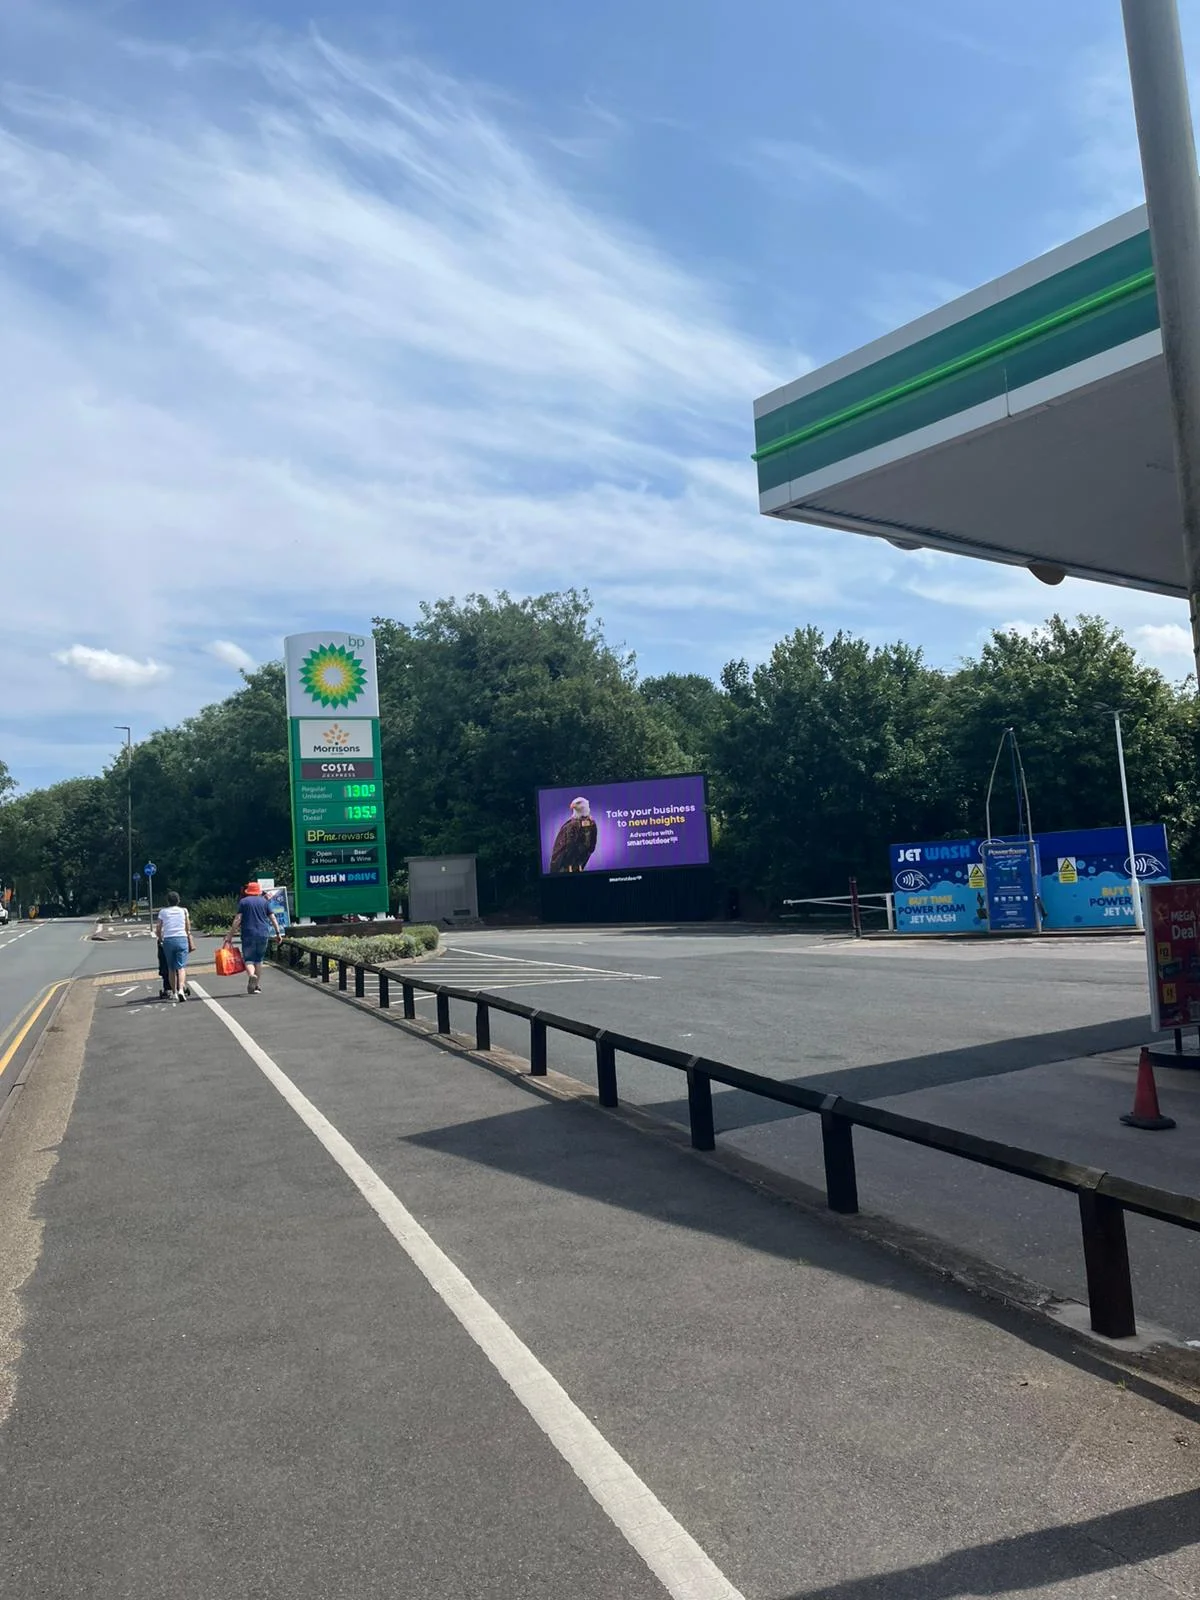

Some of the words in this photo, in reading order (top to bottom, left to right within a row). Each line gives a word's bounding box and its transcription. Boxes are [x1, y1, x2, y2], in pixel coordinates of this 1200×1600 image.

[348, 636, 365, 649] bp
[313, 742, 360, 753] Morrisons
[321, 764, 355, 772] COSTA
[302, 792, 332, 800] Unleaded
[606, 810, 628, 818] Take
[630, 808, 652, 818] your
[653, 804, 696, 814] business
[650, 816, 686, 826] heights
[338, 832, 376, 841] rewards
[630, 830, 659, 838] Advertise
[627, 838, 671, 846] smartoutdoor
[898, 849, 922, 862] JET
[924, 845, 970, 860] WASH
[348, 872, 377, 881] DRIVE
[1090, 897, 1132, 907] POWER
[898, 905, 934, 914] POWER
[936, 904, 966, 912] FOAM
[1104, 908, 1120, 916] JET
[910, 914, 924, 924] JET
[926, 914, 956, 922] WASH
